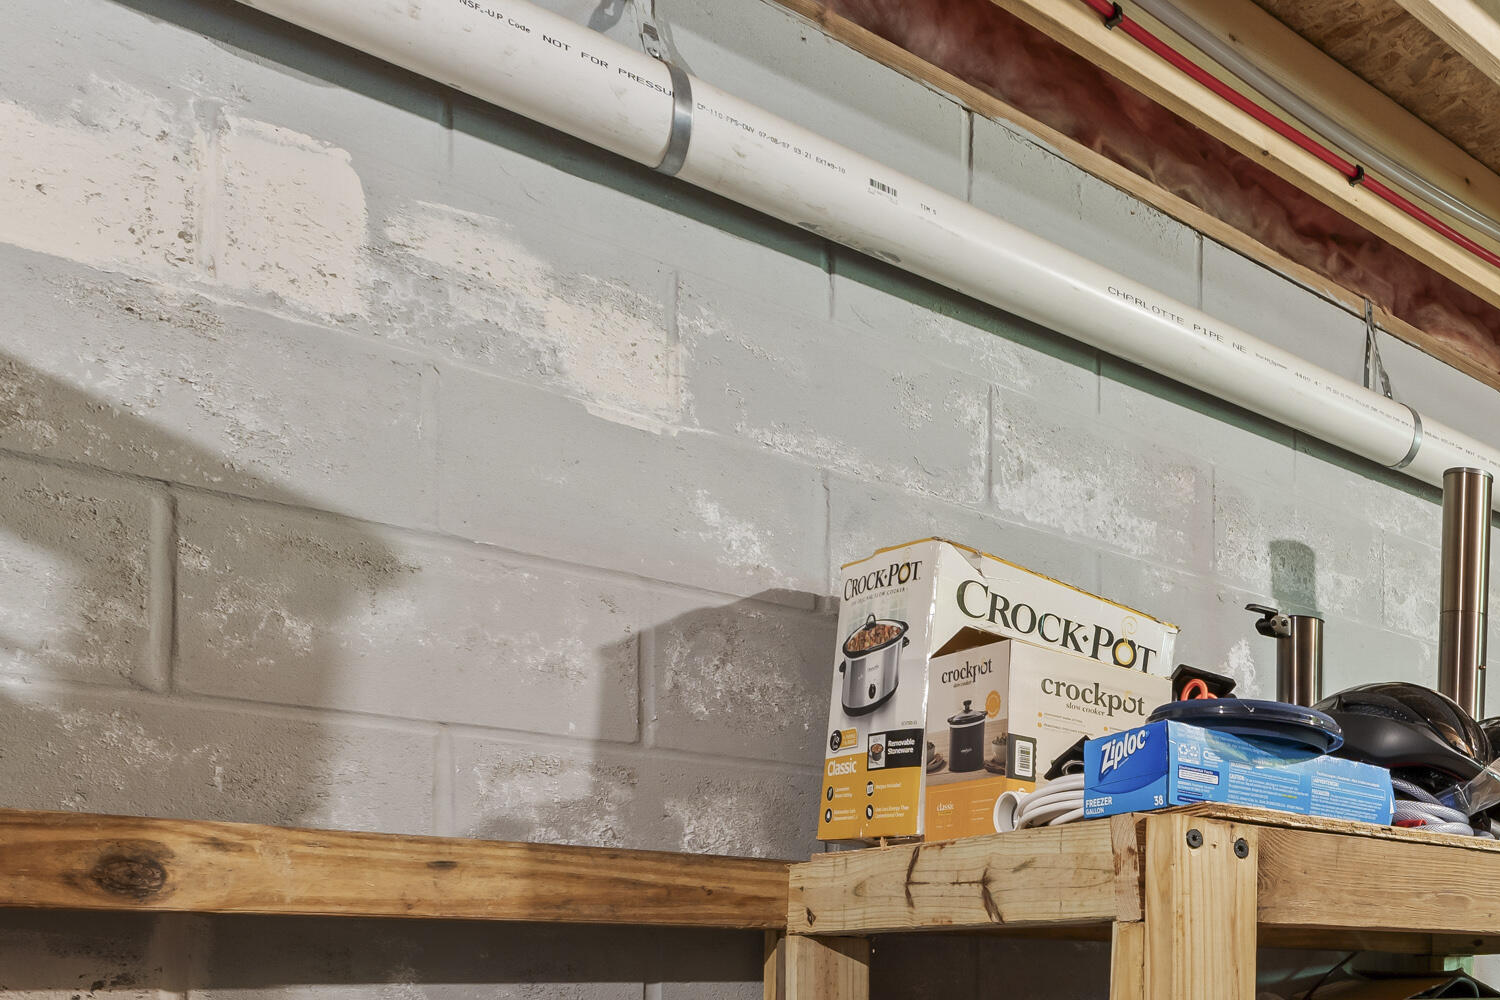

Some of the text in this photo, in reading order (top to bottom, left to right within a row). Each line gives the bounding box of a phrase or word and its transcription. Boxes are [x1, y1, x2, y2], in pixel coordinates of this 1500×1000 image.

[508, 18, 531, 34] Code
[542, 34, 572, 51] NOT
[581, 51, 609, 69] FOR
[618, 68, 675, 98] PRESSU
[1107, 286, 1184, 325] CHARLOTTE
[1193, 324, 1224, 343] PIPE
[941, 658, 993, 684] crockpot
[1040, 677, 1145, 717] crockpot
[1082, 706, 1105, 716] cooker
[887, 738, 915, 747] Removable
[887, 747, 914, 755] Stoneware
[827, 757, 857, 776] Classic
[1085, 795, 1164, 808] FREEZER 38
